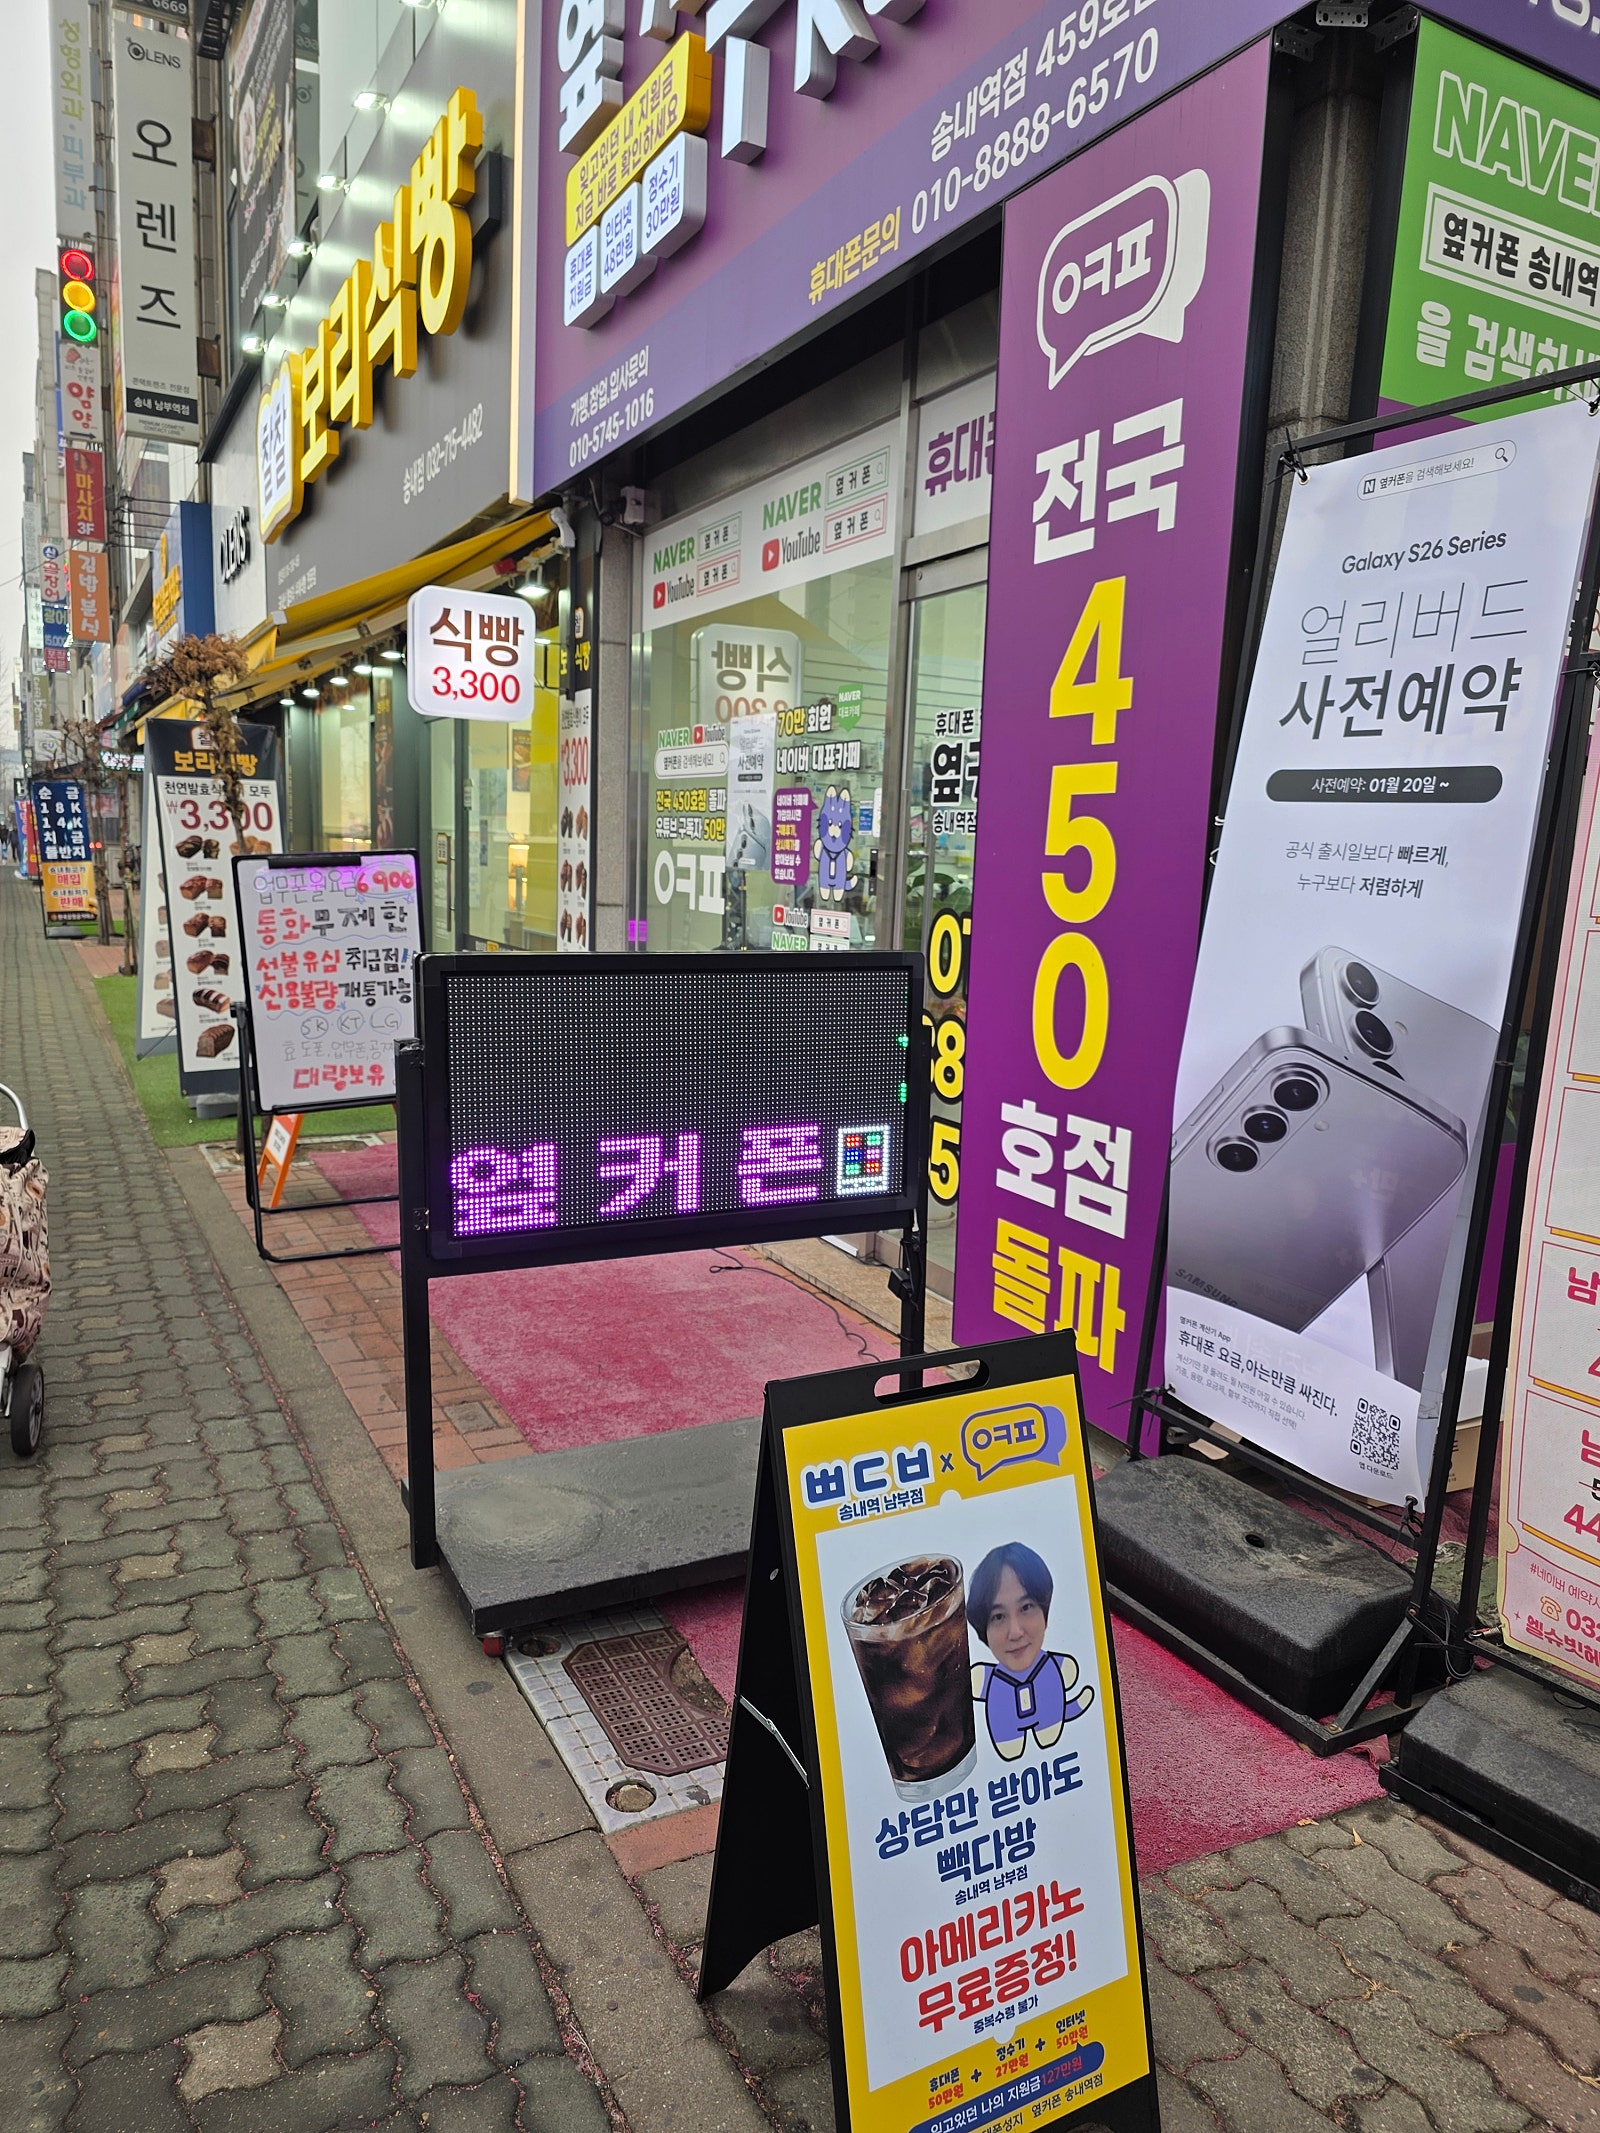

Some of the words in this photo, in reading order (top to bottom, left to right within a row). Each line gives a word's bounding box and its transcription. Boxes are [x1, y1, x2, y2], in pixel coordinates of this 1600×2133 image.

[624, 105, 635, 138] 내
[638, 60, 674, 124] 지원금
[931, 47, 1028, 162] 송내역점
[1433, 70, 1600, 214] NAVE
[575, 194, 594, 233] 지금
[598, 163, 617, 208] 바로
[621, 92, 678, 178] 확인하세요
[648, 150, 679, 202] 정수기
[808, 206, 901, 306] 휴대폰문의
[911, 27, 1158, 234] 010-8888-6570
[131, 119, 182, 330] 오렌즈
[605, 198, 632, 246] 인터넷
[645, 183, 680, 240] 30만원
[570, 240, 593, 275] 휴대폰
[603, 228, 634, 279] 48만원
[1443, 212, 1519, 279] 옆커폰
[301, 86, 483, 483] 보리식빵
[569, 274, 592, 311] 지원금
[1416, 301, 1452, 367] 을
[133, 396, 152, 410] 송내
[154, 400, 190, 416] 남부역점
[569, 387, 655, 468] 010-5745-1016
[1033, 397, 1185, 565] 전국
[1379, 472, 1414, 490] 옆커폰을
[1417, 458, 1475, 482] 검색해보세요!
[75, 473, 94, 522] 마사지
[763, 481, 822, 531] NAVER
[77, 522, 95, 535] 3F
[781, 527, 821, 564] YouTube
[653, 537, 695, 575] NAVER
[1342, 551, 1405, 574] Galaxy
[1408, 539, 1443, 563] S26
[1447, 531, 1507, 556] Series
[667, 574, 695, 604] YouTube
[430, 607, 525, 667] 식빵
[1301, 580, 1528, 665] 얼리버드
[432, 666, 521, 703] 3,300
[838, 690, 861, 702] NAVER
[1279, 658, 1522, 740] 사전예약
[778, 708, 805, 737] 70만
[807, 703, 831, 733] 회원
[936, 709, 974, 737] 휴대폰
[659, 730, 690, 748] NAVER
[777, 745, 809, 774] 네이버
[812, 741, 862, 772] 대표카페
[249, 786, 272, 797] 모두
[656, 789, 672, 812] 전국
[673, 788, 707, 813] 450호점
[708, 788, 726, 812] 돌파
[1311, 777, 1366, 793] 사전예약:
[1369, 776, 1400, 793] 01월
[1402, 775, 1436, 793] 20일
[655, 817, 678, 839] 유튜브
[679, 816, 702, 840] 구독자
[703, 816, 726, 841] 50만
[1032, 575, 1133, 1090] 450
[45, 844, 87, 859] 돌반지
[1285, 841, 1315, 859] 공식
[1318, 842, 1394, 863] 출시일보다
[1397, 845, 1449, 868] 빠르게,
[1297, 873, 1356, 894] 누구보다
[1359, 876, 1424, 899] 저렴하게
[784, 908, 808, 926] YouTube
[773, 931, 807, 950] NAVER
[256, 949, 341, 982] 선불유심
[371, 1012, 400, 1031] LG
[293, 1063, 386, 1092] 대량보유
[996, 1098, 1132, 1239] 호점
[993, 1218, 1126, 1374] 돌파
[1199, 1323, 1217, 1337] 계산기
[1217, 1331, 1232, 1343] App
[1178, 1330, 1215, 1357] 휴대폰
[1298, 1383, 1338, 1417] 싸진다.
[1240, 1394, 1267, 1416] 조건까지
[1268, 1407, 1280, 1421] 직접
[1271, 1396, 1279, 1405] 수
[1279, 1399, 1307, 1420] 있습니다.
[1358, 1461, 1366, 1471] 앱
[1366, 1465, 1394, 1480] 다운로드
[838, 1498, 881, 1522] 송내역
[884, 1488, 924, 1512] 남부점
[1530, 1562, 1566, 1593] #네이버
[874, 1787, 979, 1860] 상담만
[986, 1750, 1084, 1818] 받아도
[936, 1816, 1037, 1884] 빽다방
[954, 1877, 991, 1906] 송내역
[992, 1864, 1029, 1895] 남부점
[900, 1879, 1085, 1983] 아메리카노
[918, 1929, 1078, 2034] 무료증정!
[973, 2006, 1016, 2034] 중복수령
[1018, 1994, 1039, 2014] 불가
[1055, 2009, 1086, 2034] 인터넷
[996, 2037, 1025, 2062] 정수기
[1056, 2024, 1089, 2050] 50만원
[928, 2067, 961, 2093] 휴대폰
[995, 2052, 1029, 2079] 27만원
[927, 2082, 965, 2110] 50만원
[981, 2094, 1005, 2116] 나의
[1007, 2076, 1042, 2102] 지원금
[1041, 2055, 1083, 2087] 127만원
[1031, 2094, 1062, 2119] 옆커폰
[1064, 2072, 1104, 2102] 송내역점
